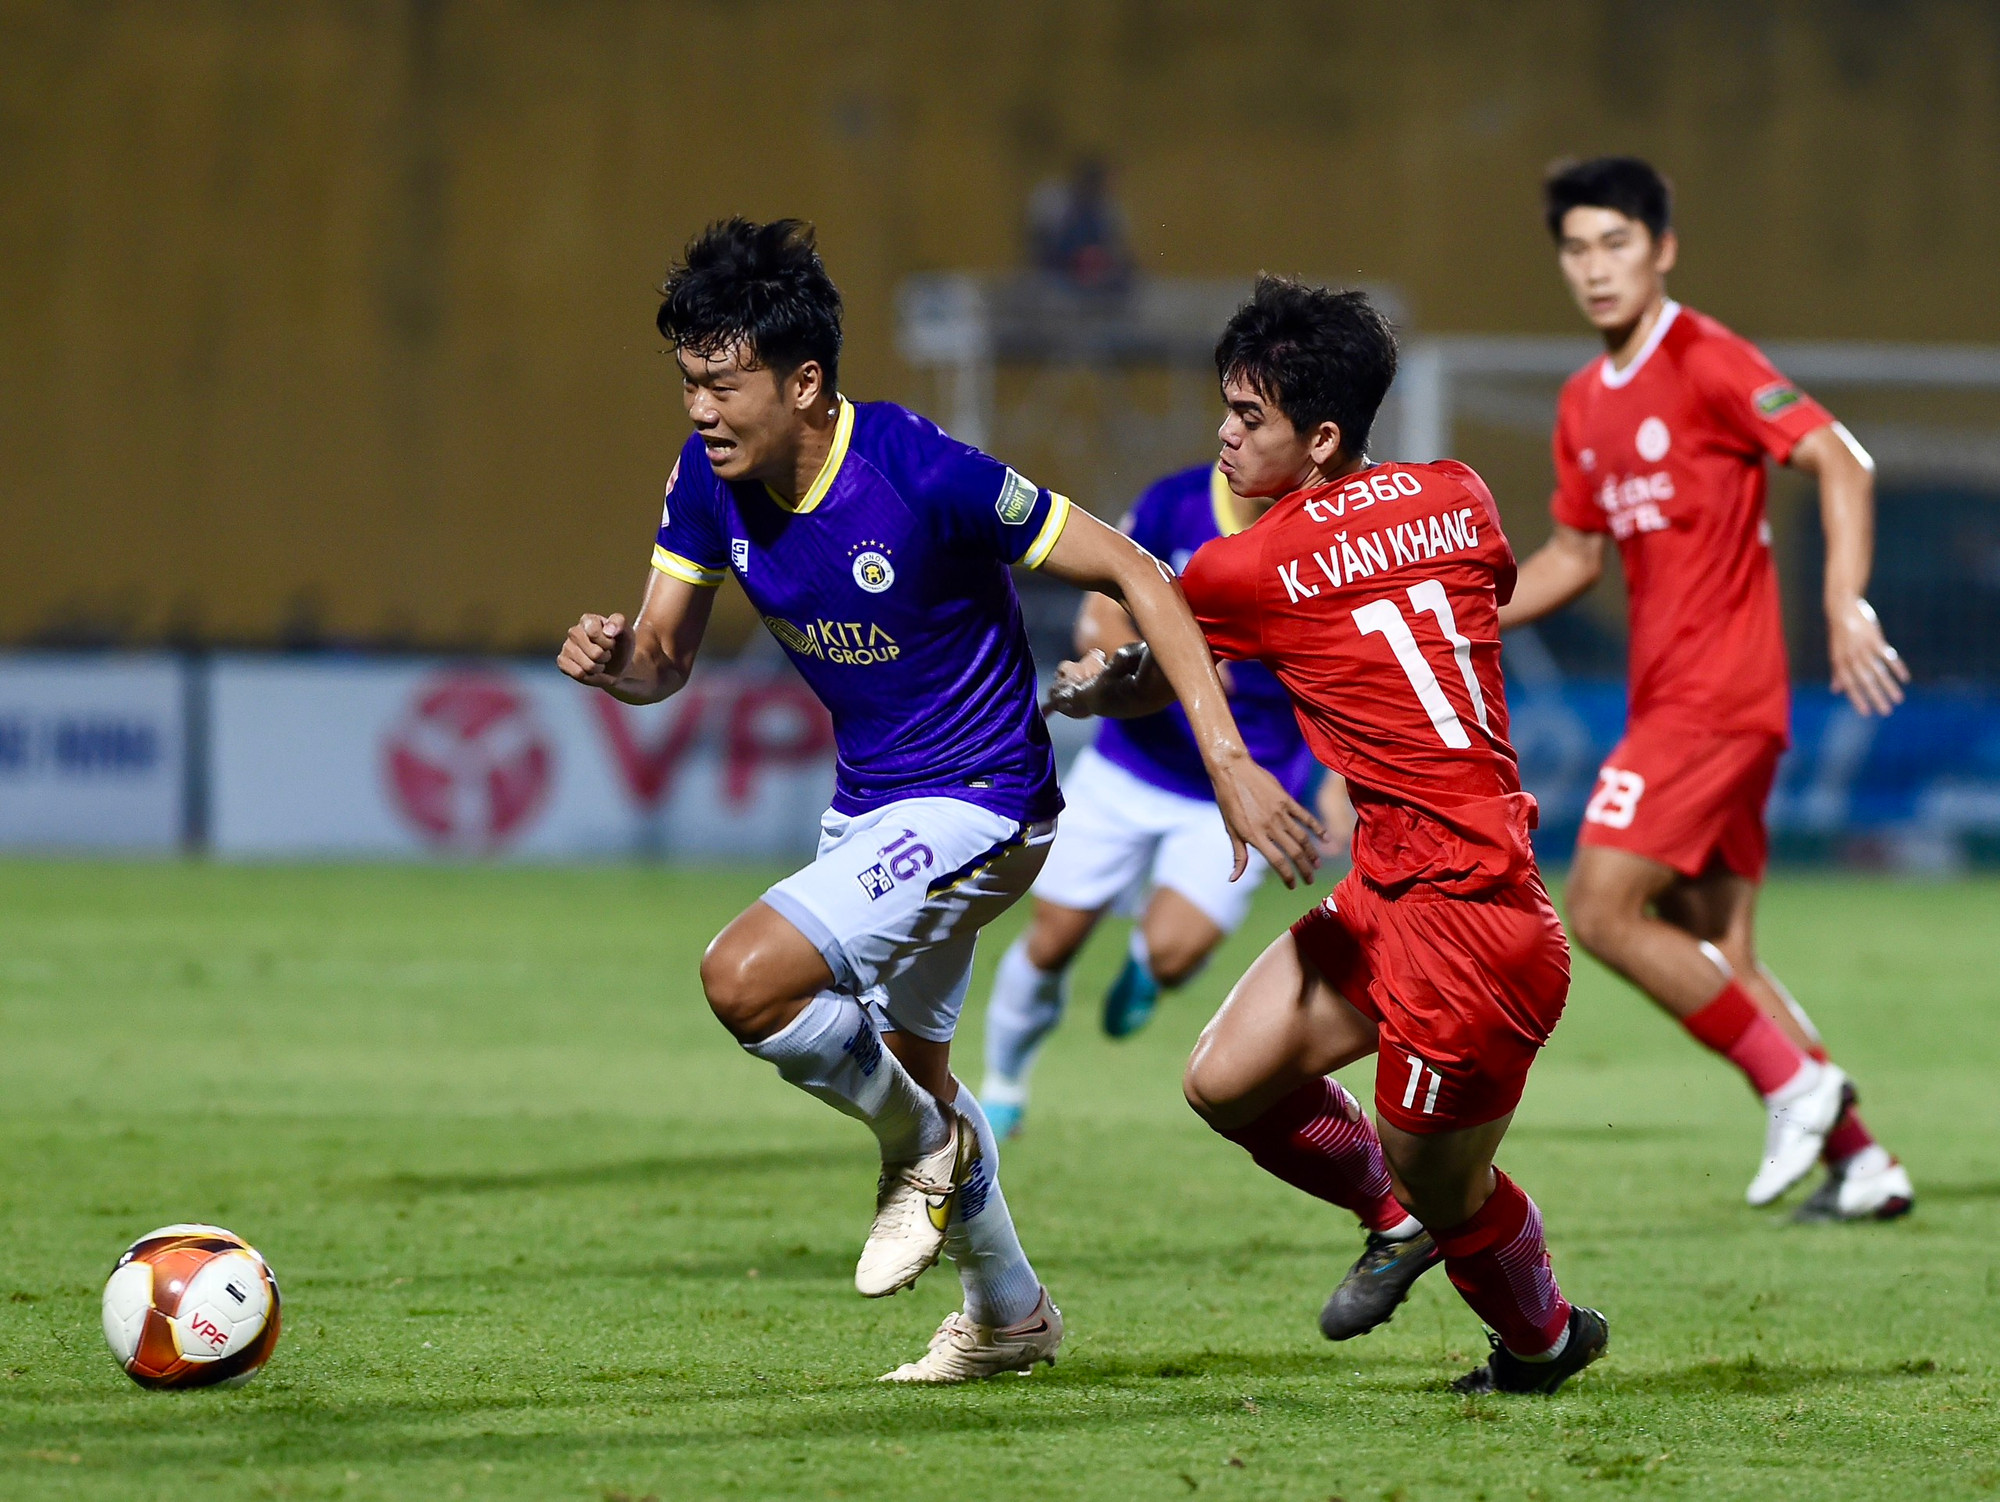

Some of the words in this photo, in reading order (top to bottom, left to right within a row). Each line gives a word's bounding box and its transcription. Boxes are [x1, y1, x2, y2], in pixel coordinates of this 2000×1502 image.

[1005, 489, 1026, 521] NIGHT
[1303, 472, 1423, 523] tv360
[857, 554, 885, 566] HANOI
[1277, 560, 1320, 604] K.
[1312, 531, 1390, 588] VĂN
[1384, 507, 1479, 566] KHANG
[817, 618, 897, 648] KITA
[827, 645, 901, 666] GROUP
[1350, 578, 1495, 750] 11
[1585, 766, 1646, 829] 23
[876, 828, 934, 881] 16
[1401, 1054, 1443, 1114] 11
[190, 1312, 229, 1345] VPF
